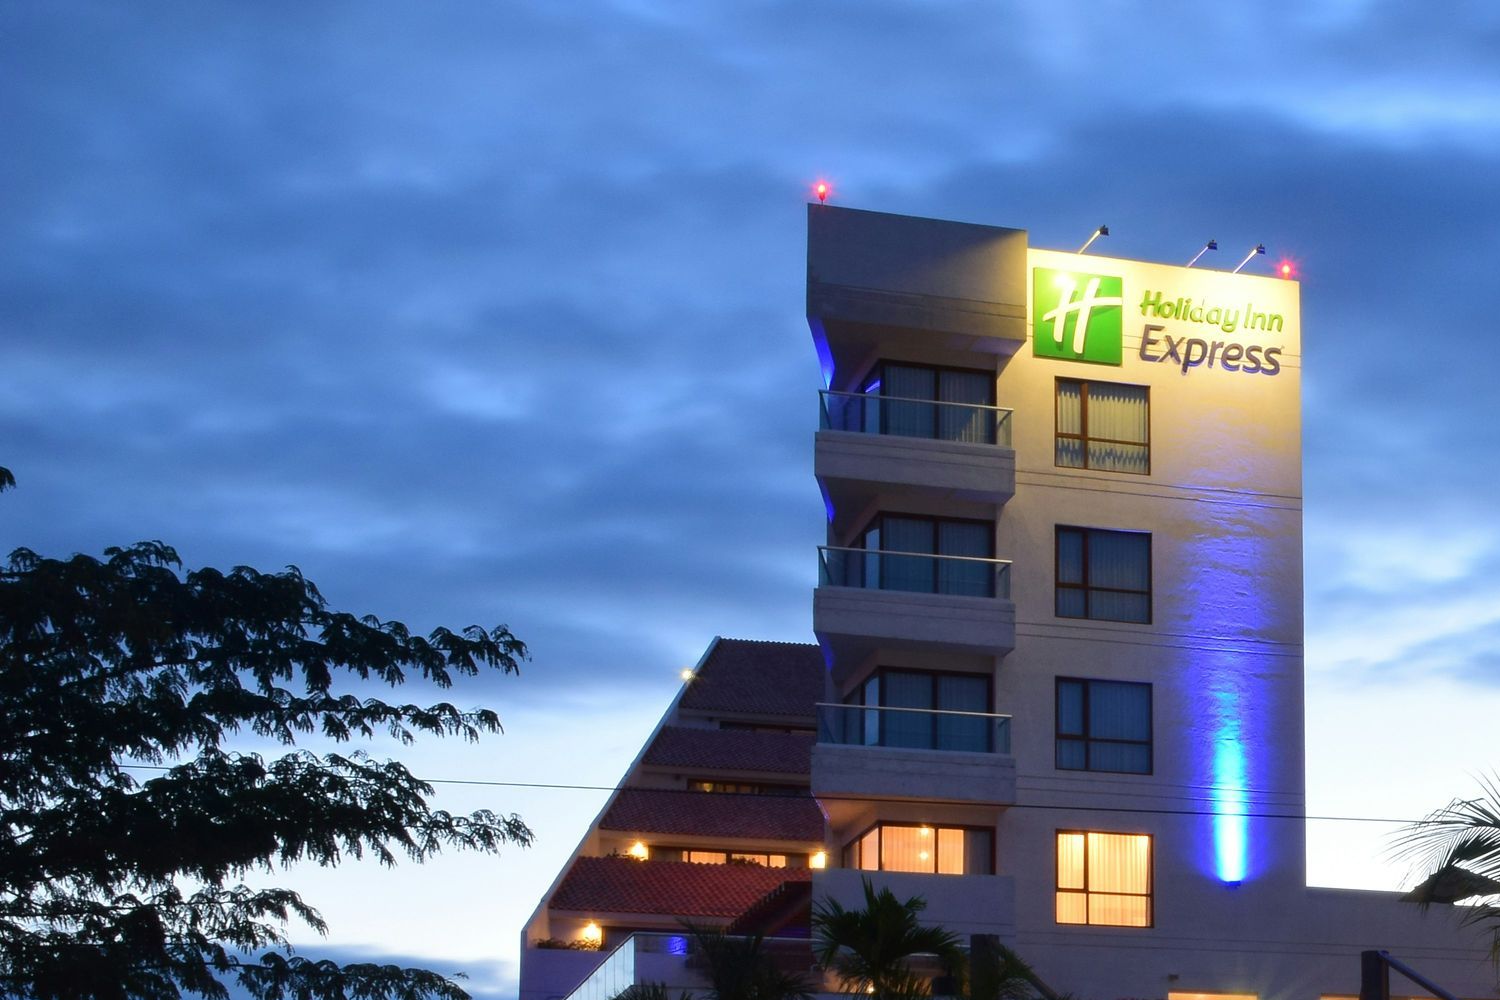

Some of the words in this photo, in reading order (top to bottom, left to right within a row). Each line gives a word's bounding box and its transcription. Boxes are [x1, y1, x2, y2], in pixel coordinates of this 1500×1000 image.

[1139, 289, 1239, 333] Holiday
[1243, 302, 1284, 332] Inn
[1139, 323, 1283, 376] Express
